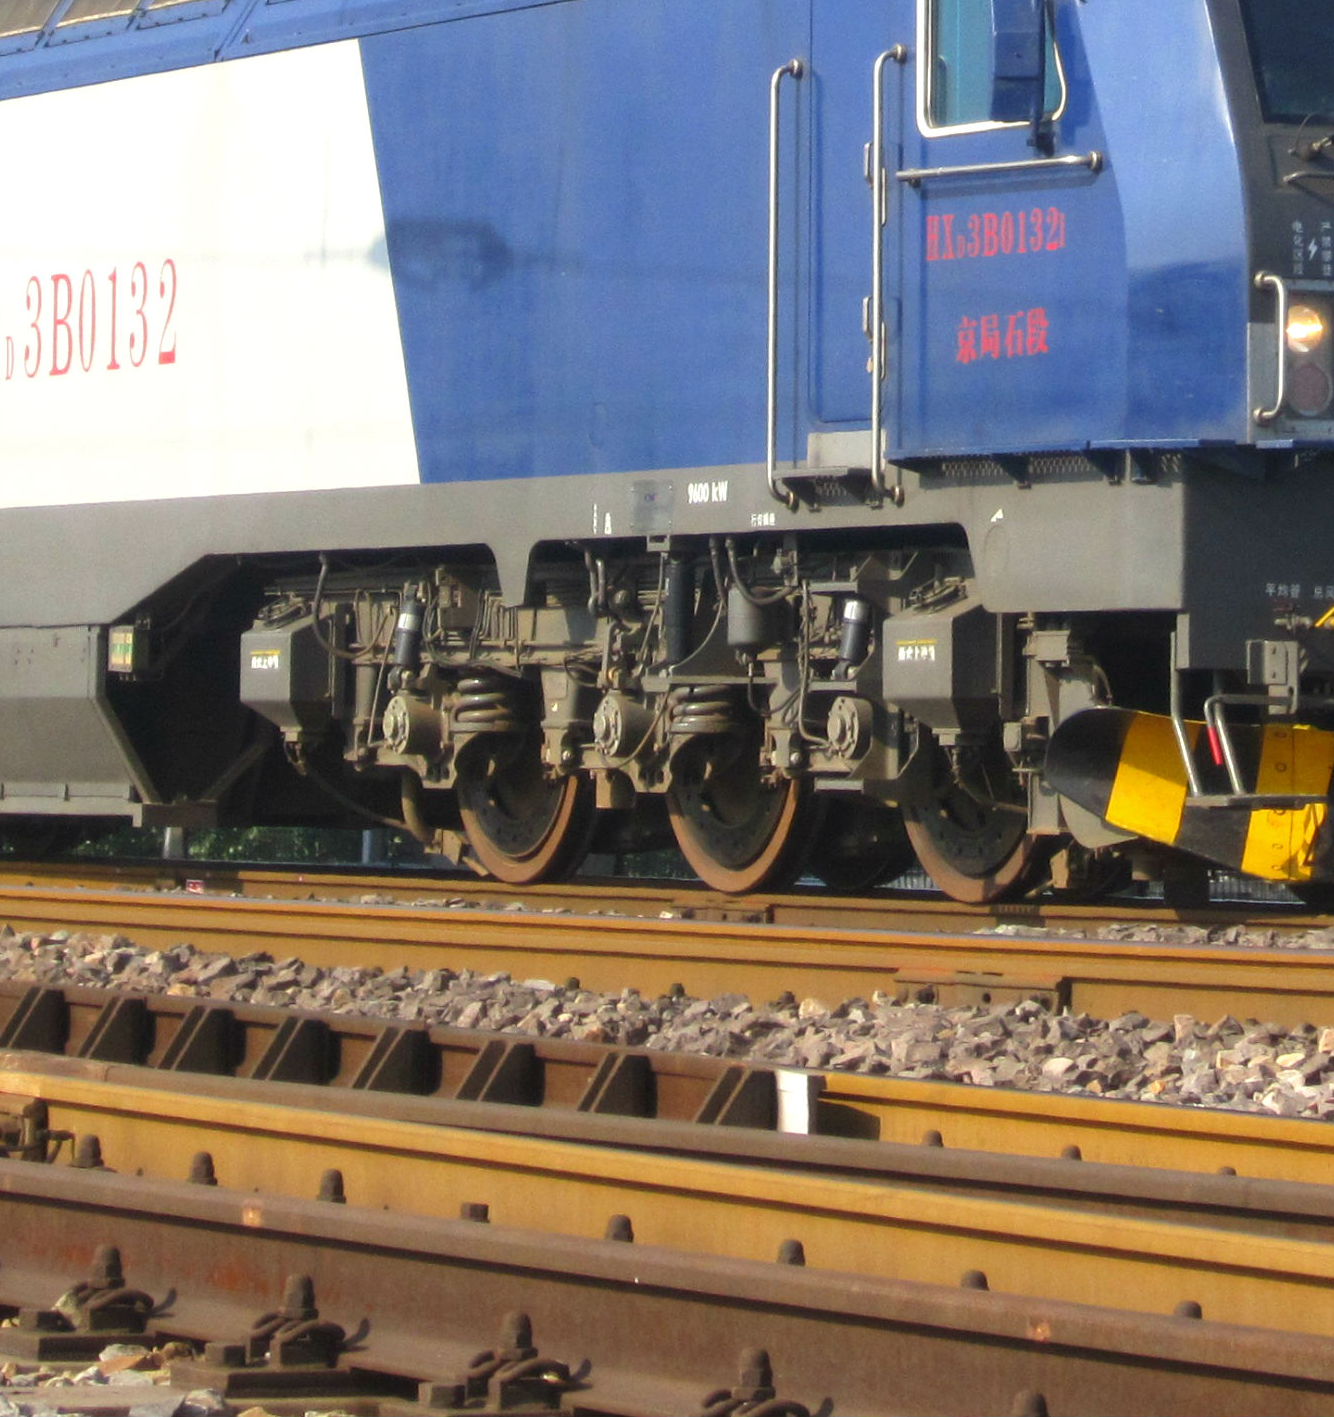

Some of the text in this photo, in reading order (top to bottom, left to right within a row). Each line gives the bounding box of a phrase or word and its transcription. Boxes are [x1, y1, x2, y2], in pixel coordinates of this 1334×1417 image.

[956, 307, 1049, 364] 京局石段
[688, 482, 710, 504] 9600
